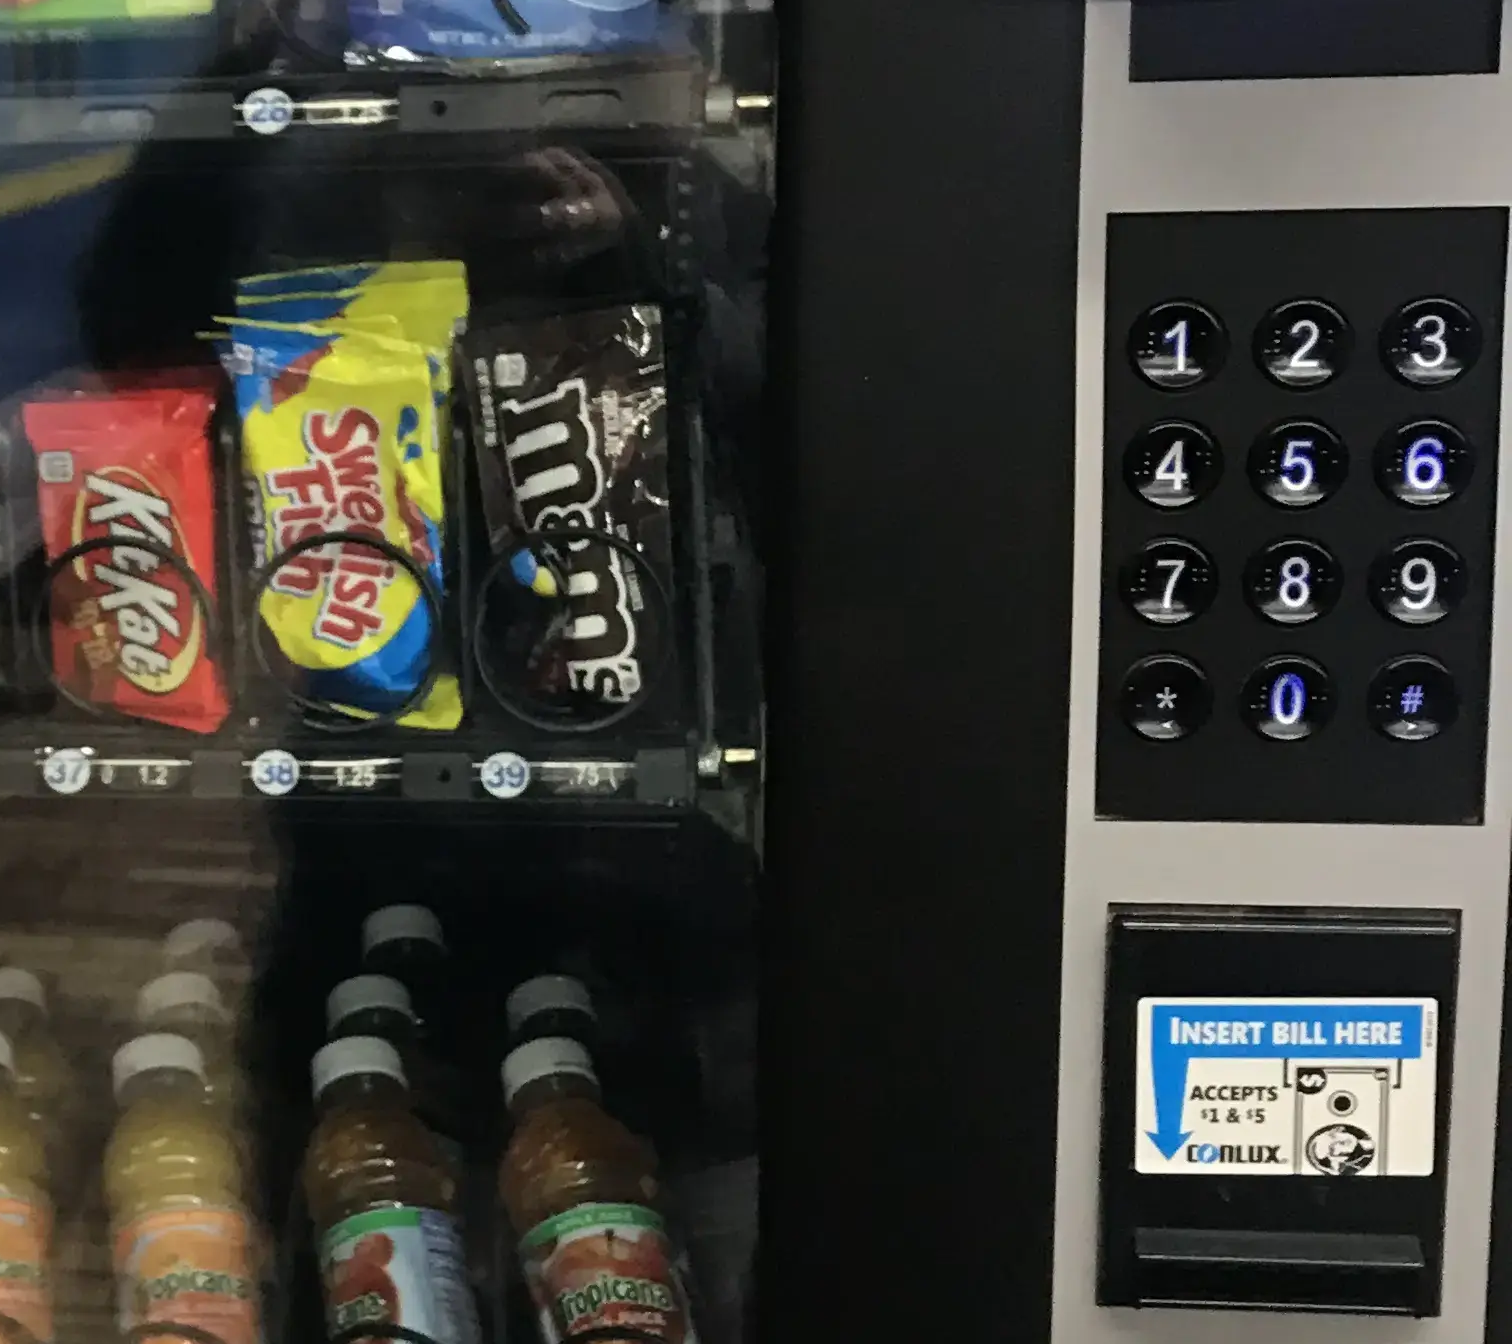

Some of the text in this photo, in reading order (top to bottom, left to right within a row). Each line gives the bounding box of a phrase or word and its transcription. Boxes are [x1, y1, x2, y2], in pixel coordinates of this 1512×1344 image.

[1163, 320, 1188, 372] 1
[1289, 319, 1321, 369] 2
[1410, 314, 1448, 369] 3
[1154, 440, 1188, 490] 4
[1280, 440, 1314, 492] 5
[1405, 437, 1446, 492] 6
[265, 455, 328, 597] Fish
[303, 406, 382, 651] Swedish
[1155, 559, 1187, 609] 7
[1278, 556, 1312, 609] 8
[1400, 556, 1437, 611] 9
[1270, 672, 1306, 725] 0
[1400, 684, 1425, 714] #
[47, 758, 87, 784] 37
[258, 758, 294, 785] 38
[487, 759, 525, 787] 39
[1170, 1015, 1267, 1046] INSERT
[1271, 1020, 1328, 1046] BILL
[1334, 1020, 1404, 1046] HERE
[1189, 1084, 1279, 1102] ACCEPTS
[1200, 1107, 1266, 1124] $1 & $5
[557, 1274, 675, 1323] Tropicana
